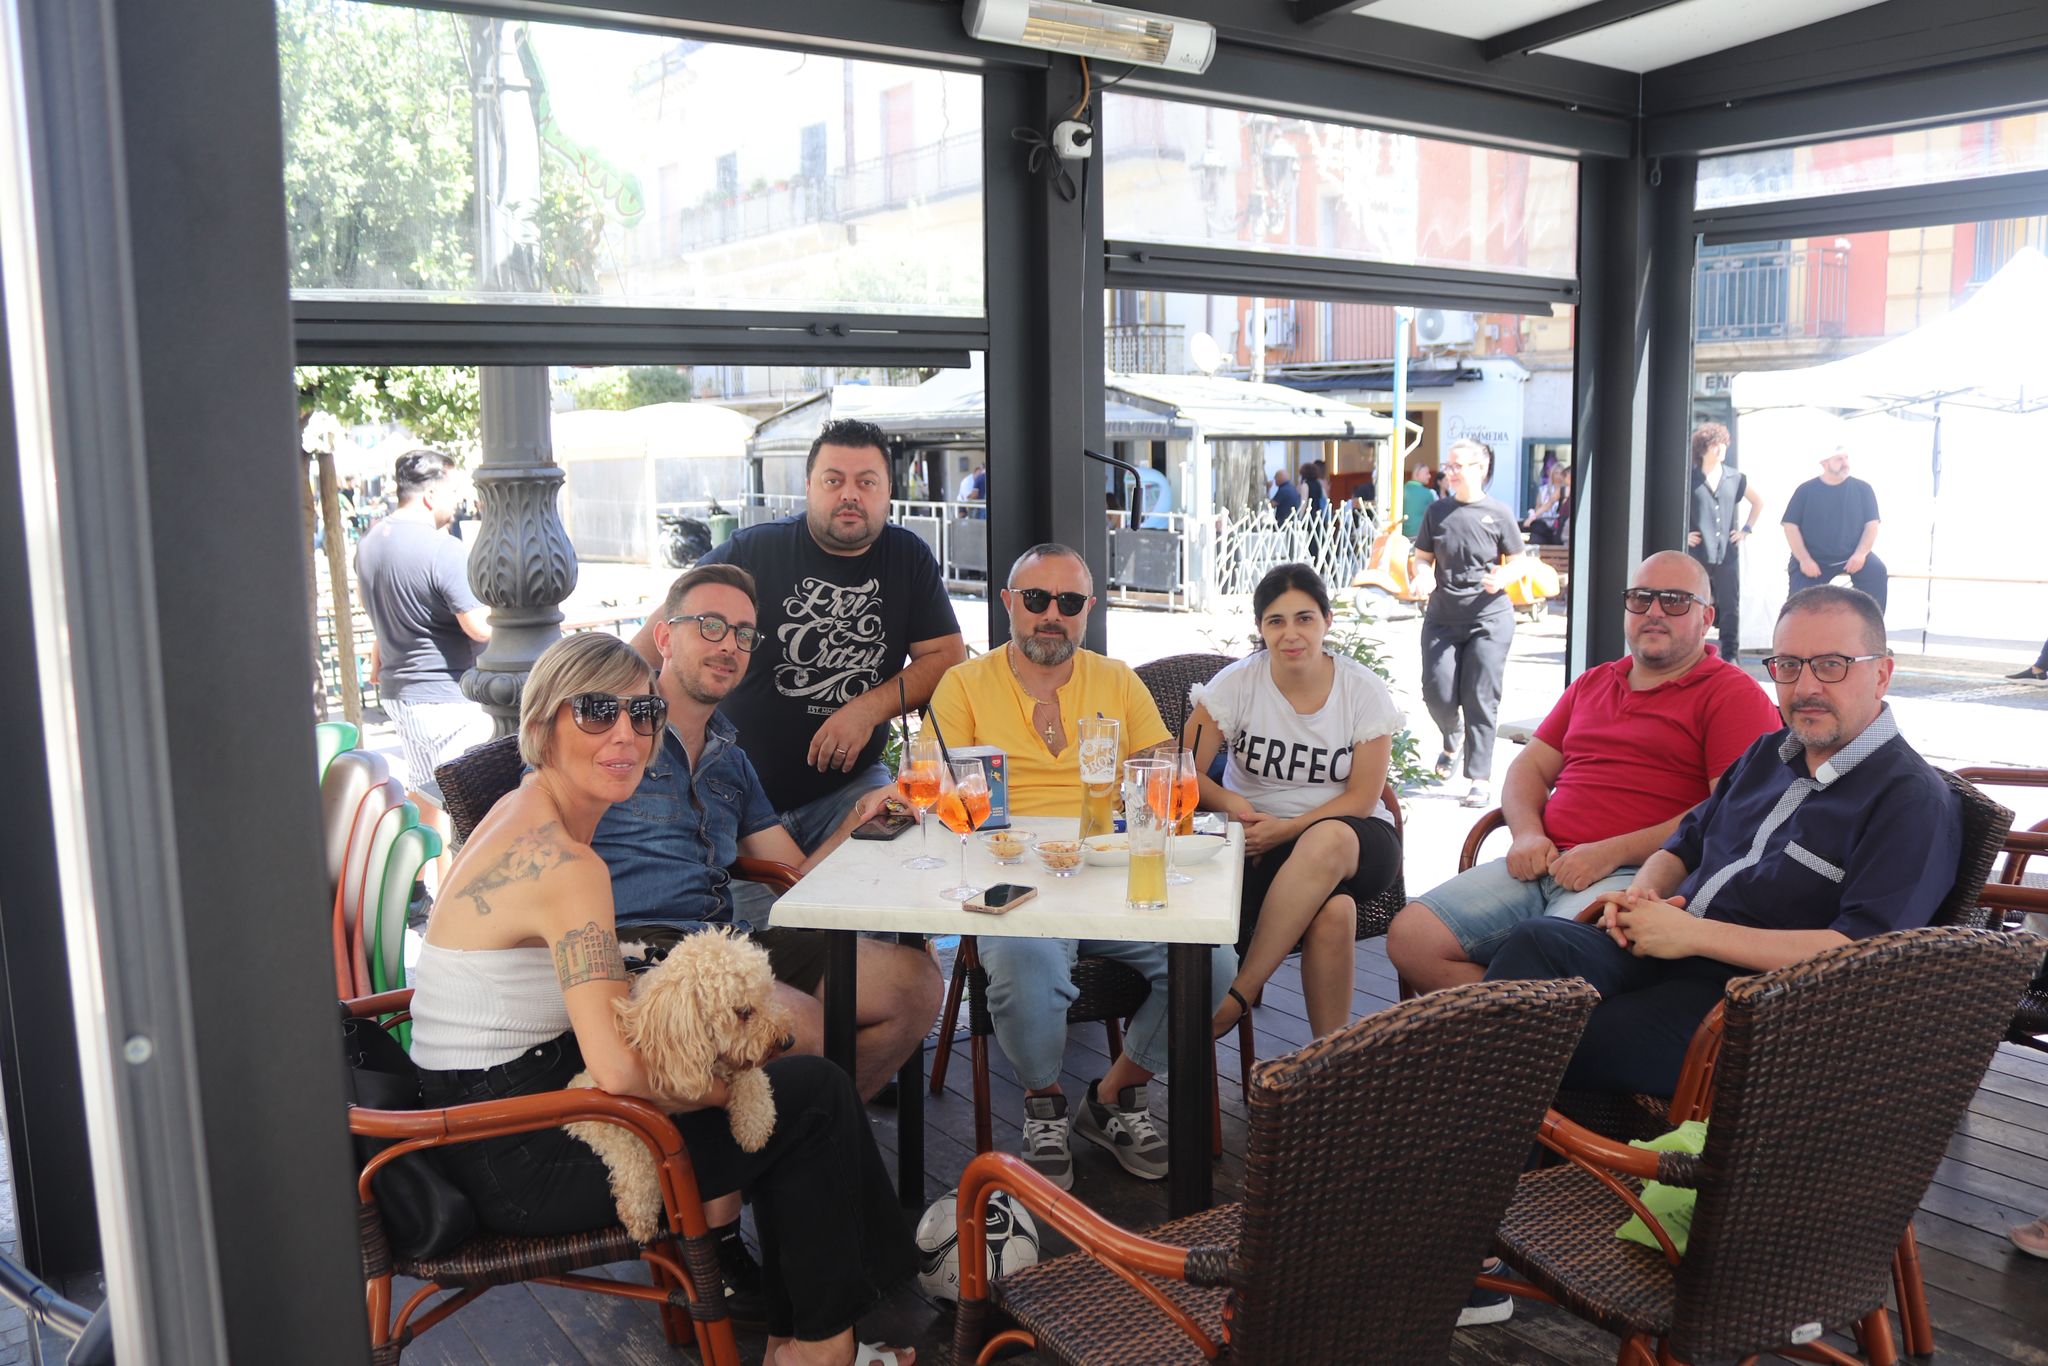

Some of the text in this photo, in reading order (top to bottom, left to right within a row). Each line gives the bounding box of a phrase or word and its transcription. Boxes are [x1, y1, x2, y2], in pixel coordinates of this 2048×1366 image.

[1705, 375, 1730, 389] EN
[777, 616, 887, 671] Crazy
[1234, 730, 1353, 784] ERFEC
